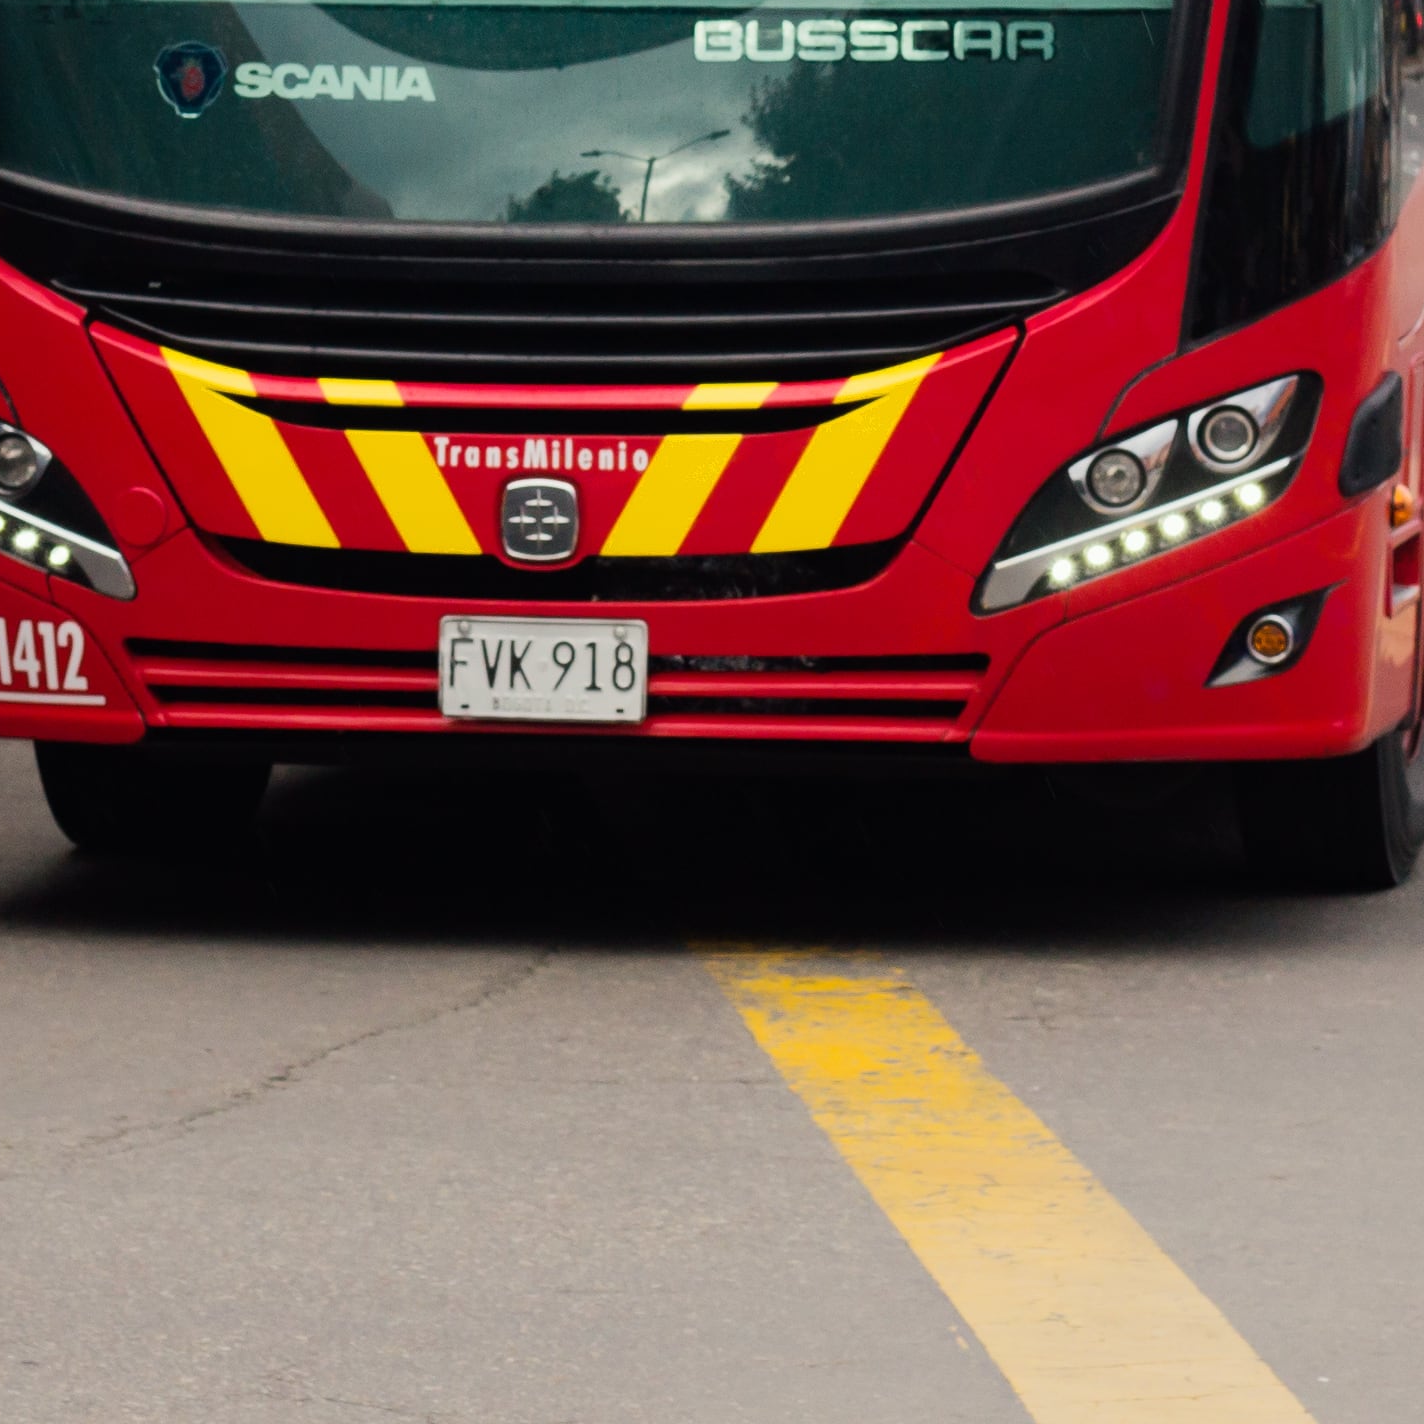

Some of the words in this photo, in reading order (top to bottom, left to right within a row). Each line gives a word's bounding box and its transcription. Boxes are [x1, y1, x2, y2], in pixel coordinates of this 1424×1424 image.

[693, 19, 1055, 62] BUSSCAR
[234, 62, 436, 102] SCANIA
[433, 436, 649, 472] TransMilenio
[449, 638, 533, 690] FVK
[551, 640, 636, 691] 918
